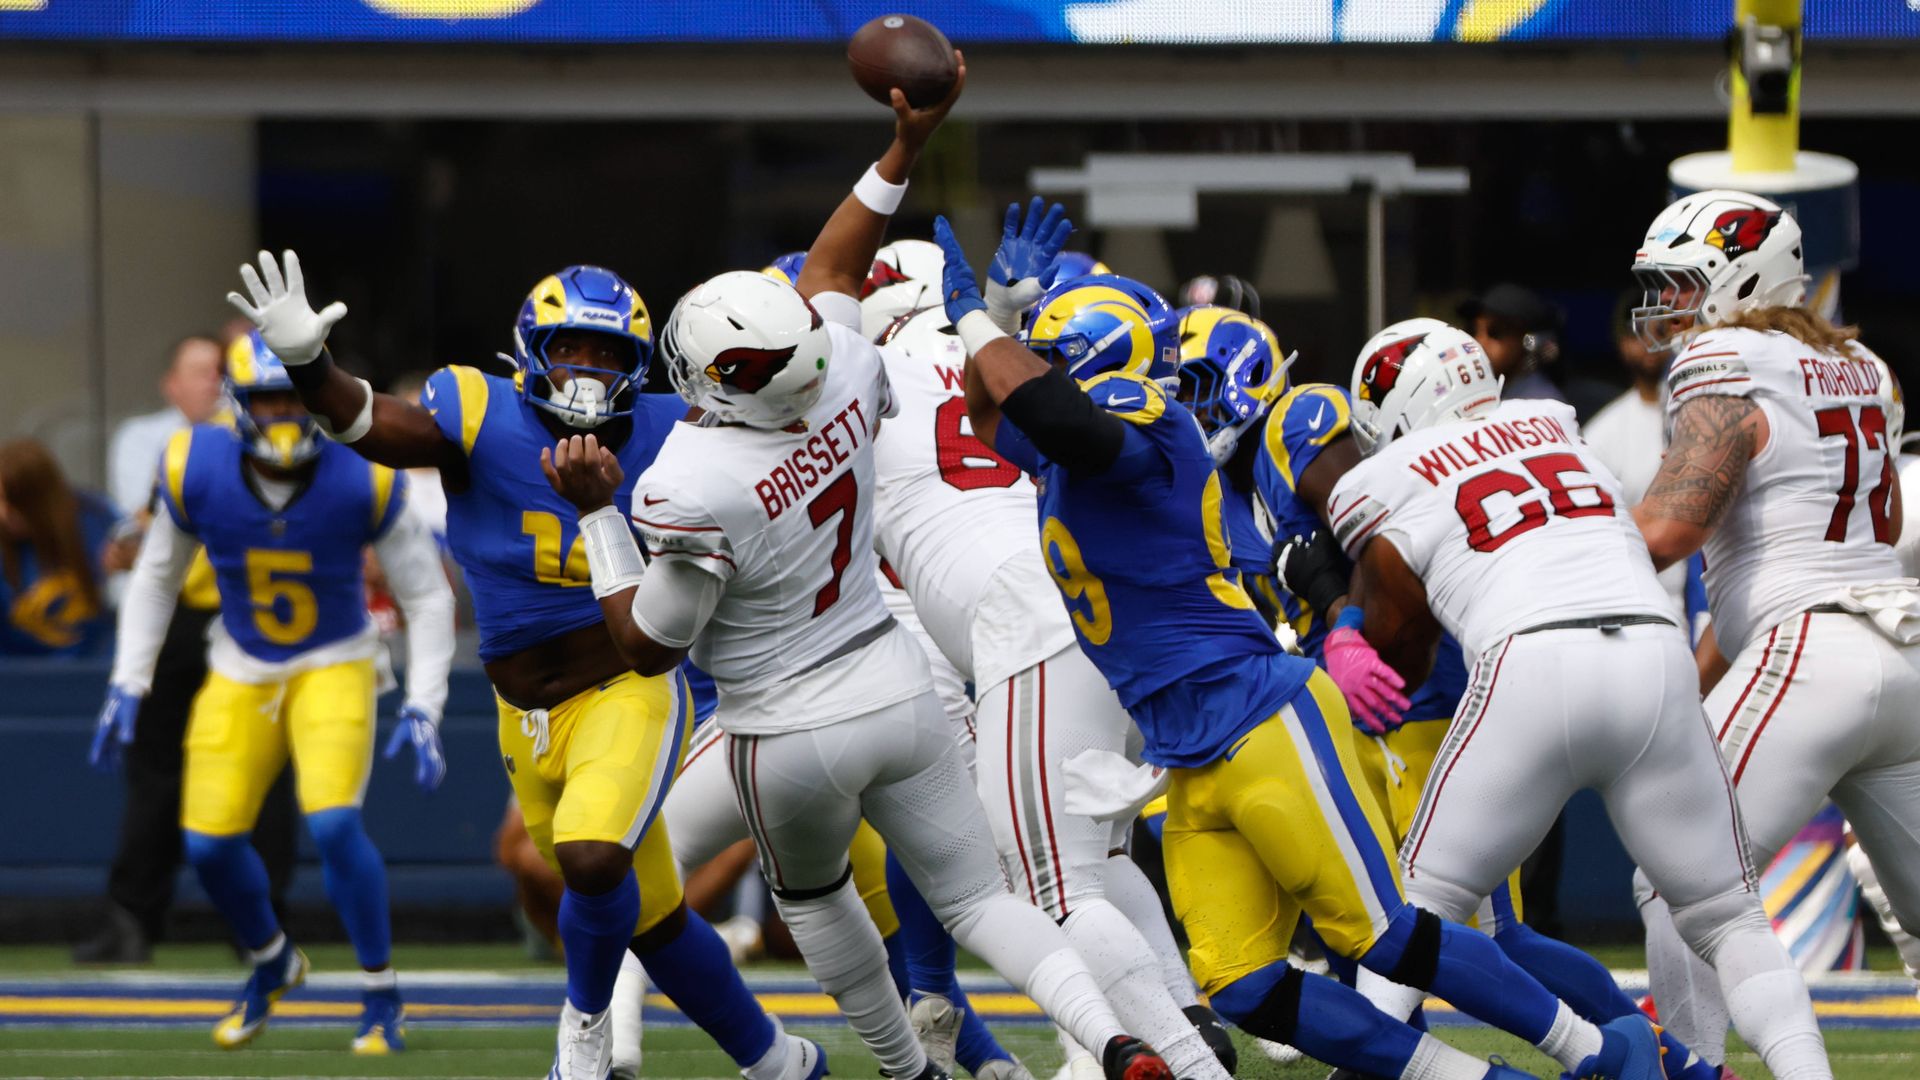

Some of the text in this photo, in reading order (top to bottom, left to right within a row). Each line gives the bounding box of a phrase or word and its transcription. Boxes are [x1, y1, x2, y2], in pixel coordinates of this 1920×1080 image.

[1457, 359, 1486, 385] 65
[754, 397, 868, 522] BRISSETT
[1408, 415, 1573, 488] WILKINSON
[1455, 451, 1616, 553] 65
[1814, 405, 1892, 545] 72
[807, 467, 858, 620] 7
[245, 547, 318, 646] 5
